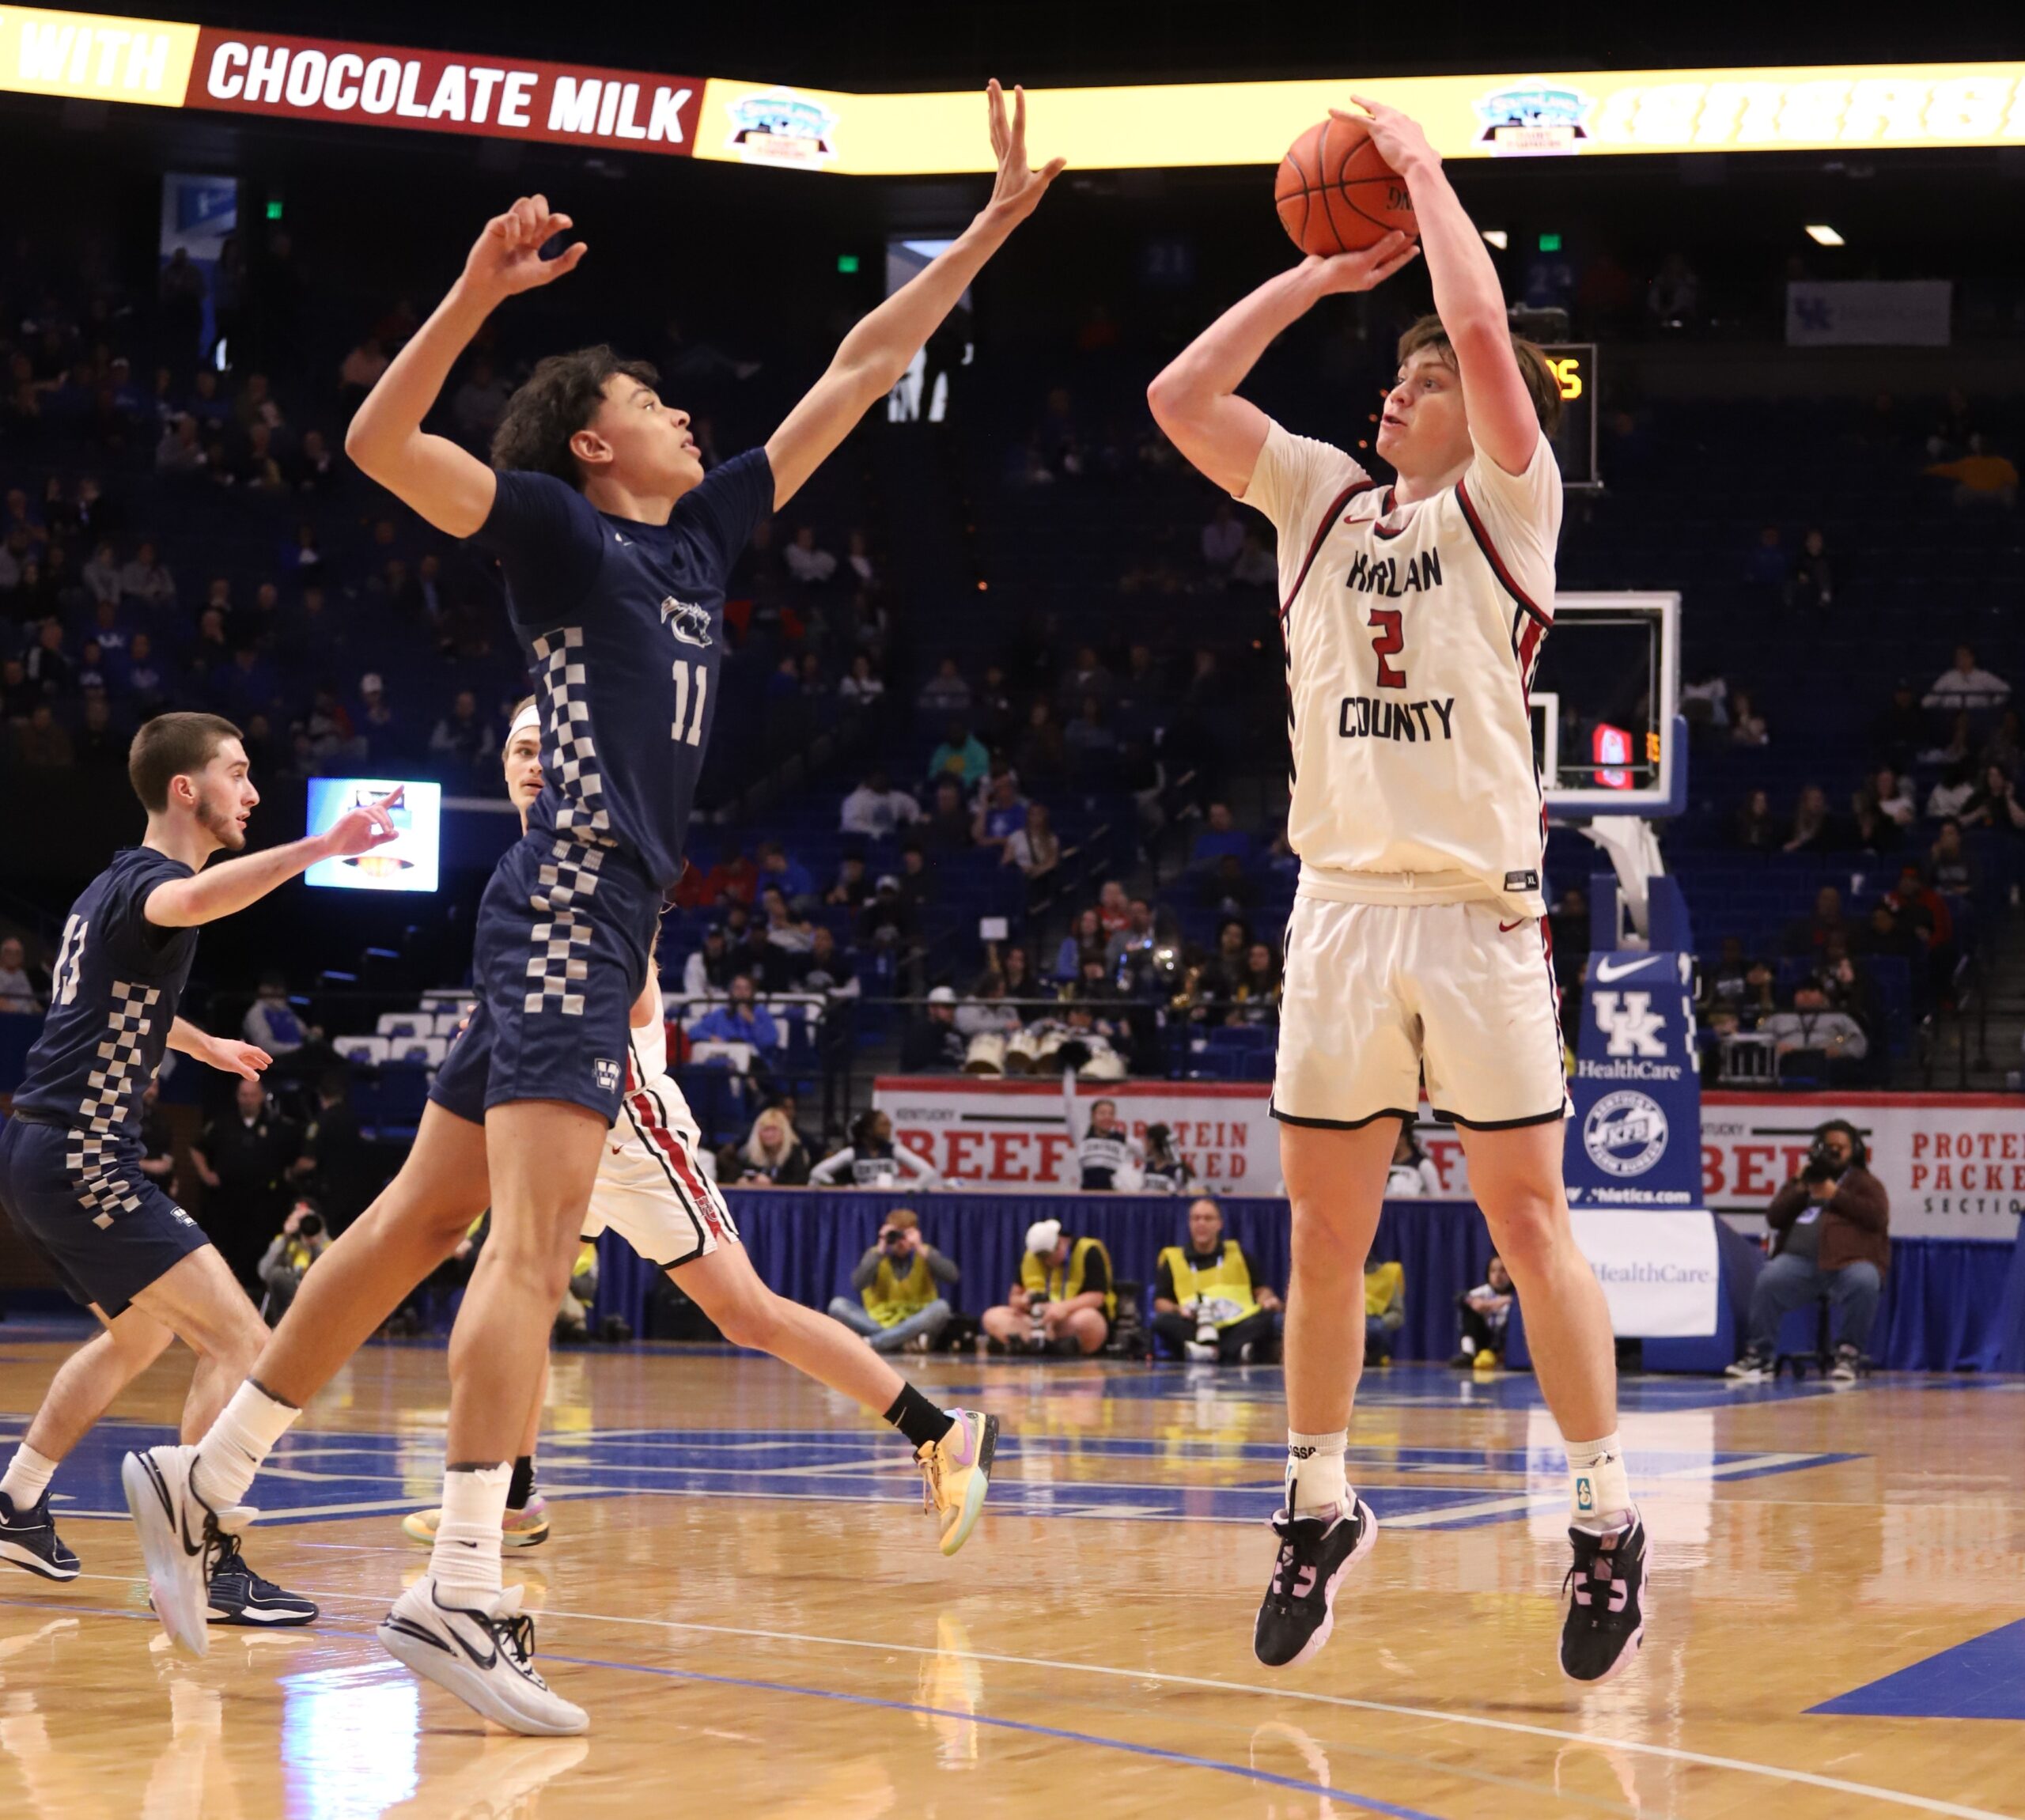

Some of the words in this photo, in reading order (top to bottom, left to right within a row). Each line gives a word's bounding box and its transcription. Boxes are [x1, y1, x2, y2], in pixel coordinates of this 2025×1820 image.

[19, 21, 170, 92] WITH
[206, 41, 539, 128] CHOCOLATE
[547, 76, 693, 143] MILK
[1544, 359, 1582, 399] 5
[1367, 608, 1406, 688] 2
[671, 659, 708, 747] 11
[1338, 696, 1455, 742] COUNTY
[1527, 876, 1536, 885] XL
[51, 914, 89, 1005] 13
[1592, 991, 1667, 1058] UK
[1578, 1058, 1682, 1080] HealthCare
[895, 1128, 1075, 1182] BEEF
[1114, 1120, 1247, 1148] RTEIN
[1911, 1132, 2025, 1160] PROTE
